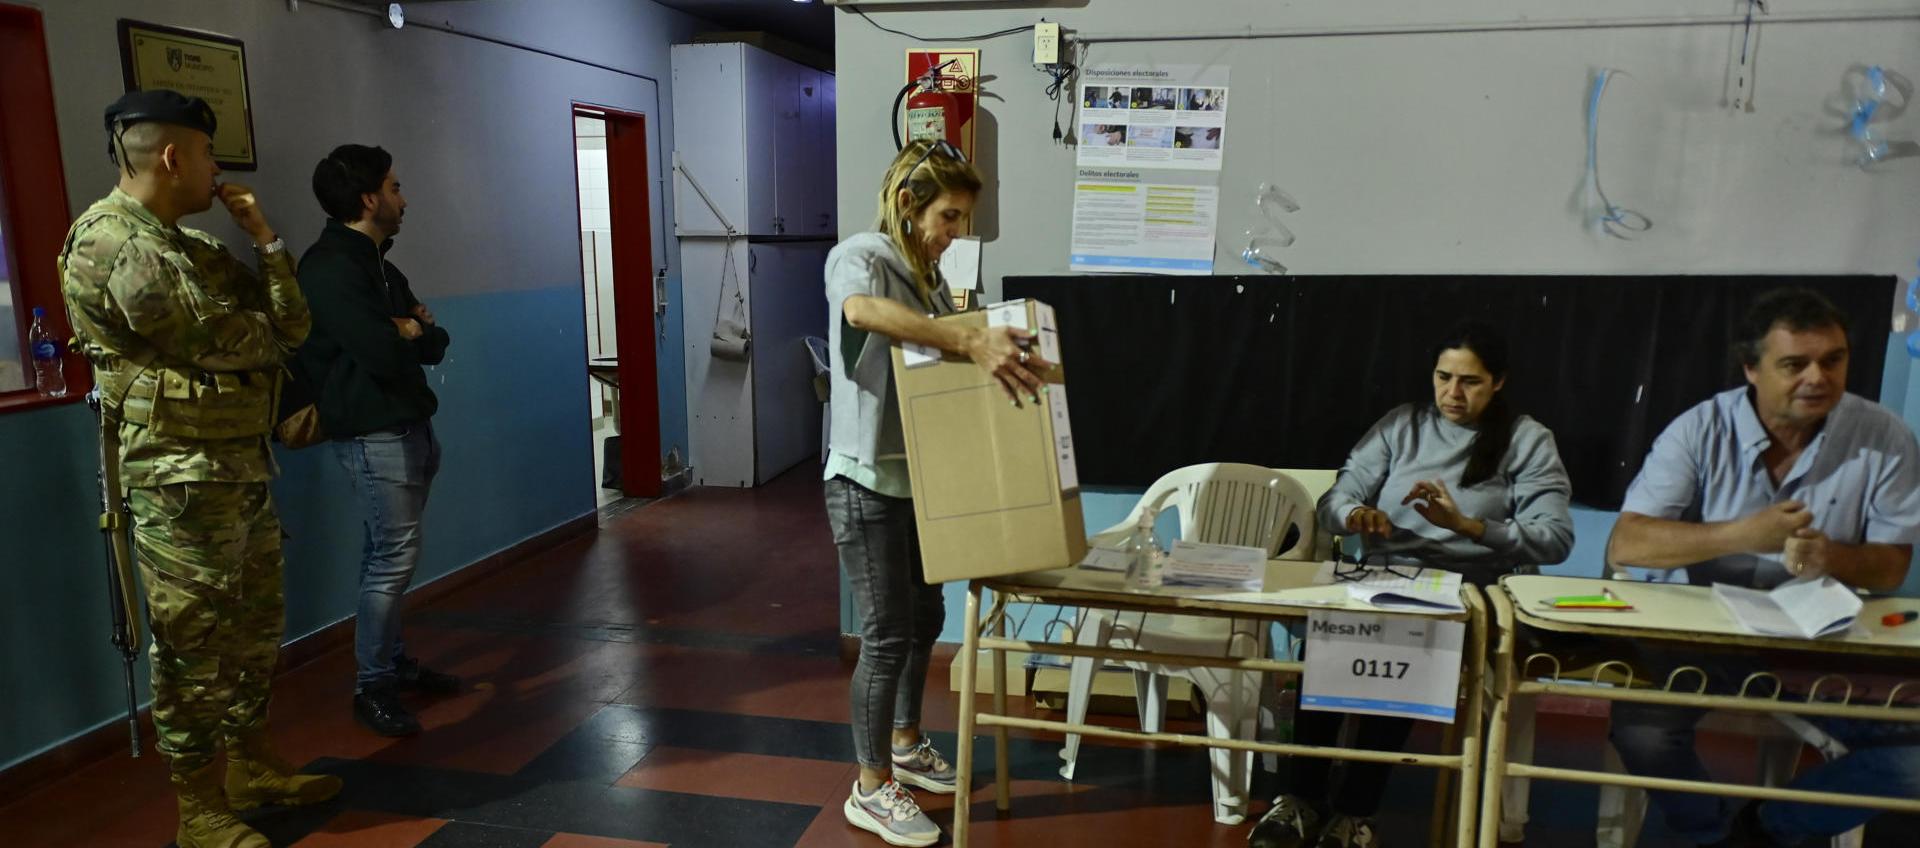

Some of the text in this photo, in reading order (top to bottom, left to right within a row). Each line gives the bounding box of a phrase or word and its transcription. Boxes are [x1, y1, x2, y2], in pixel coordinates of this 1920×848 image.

[1086, 69, 1169, 77] Disposiciones electorales
[1080, 169, 1139, 178] Delitos electorales
[1312, 620, 1381, 636] Mesa Nº
[1352, 658, 1410, 679] 0117
